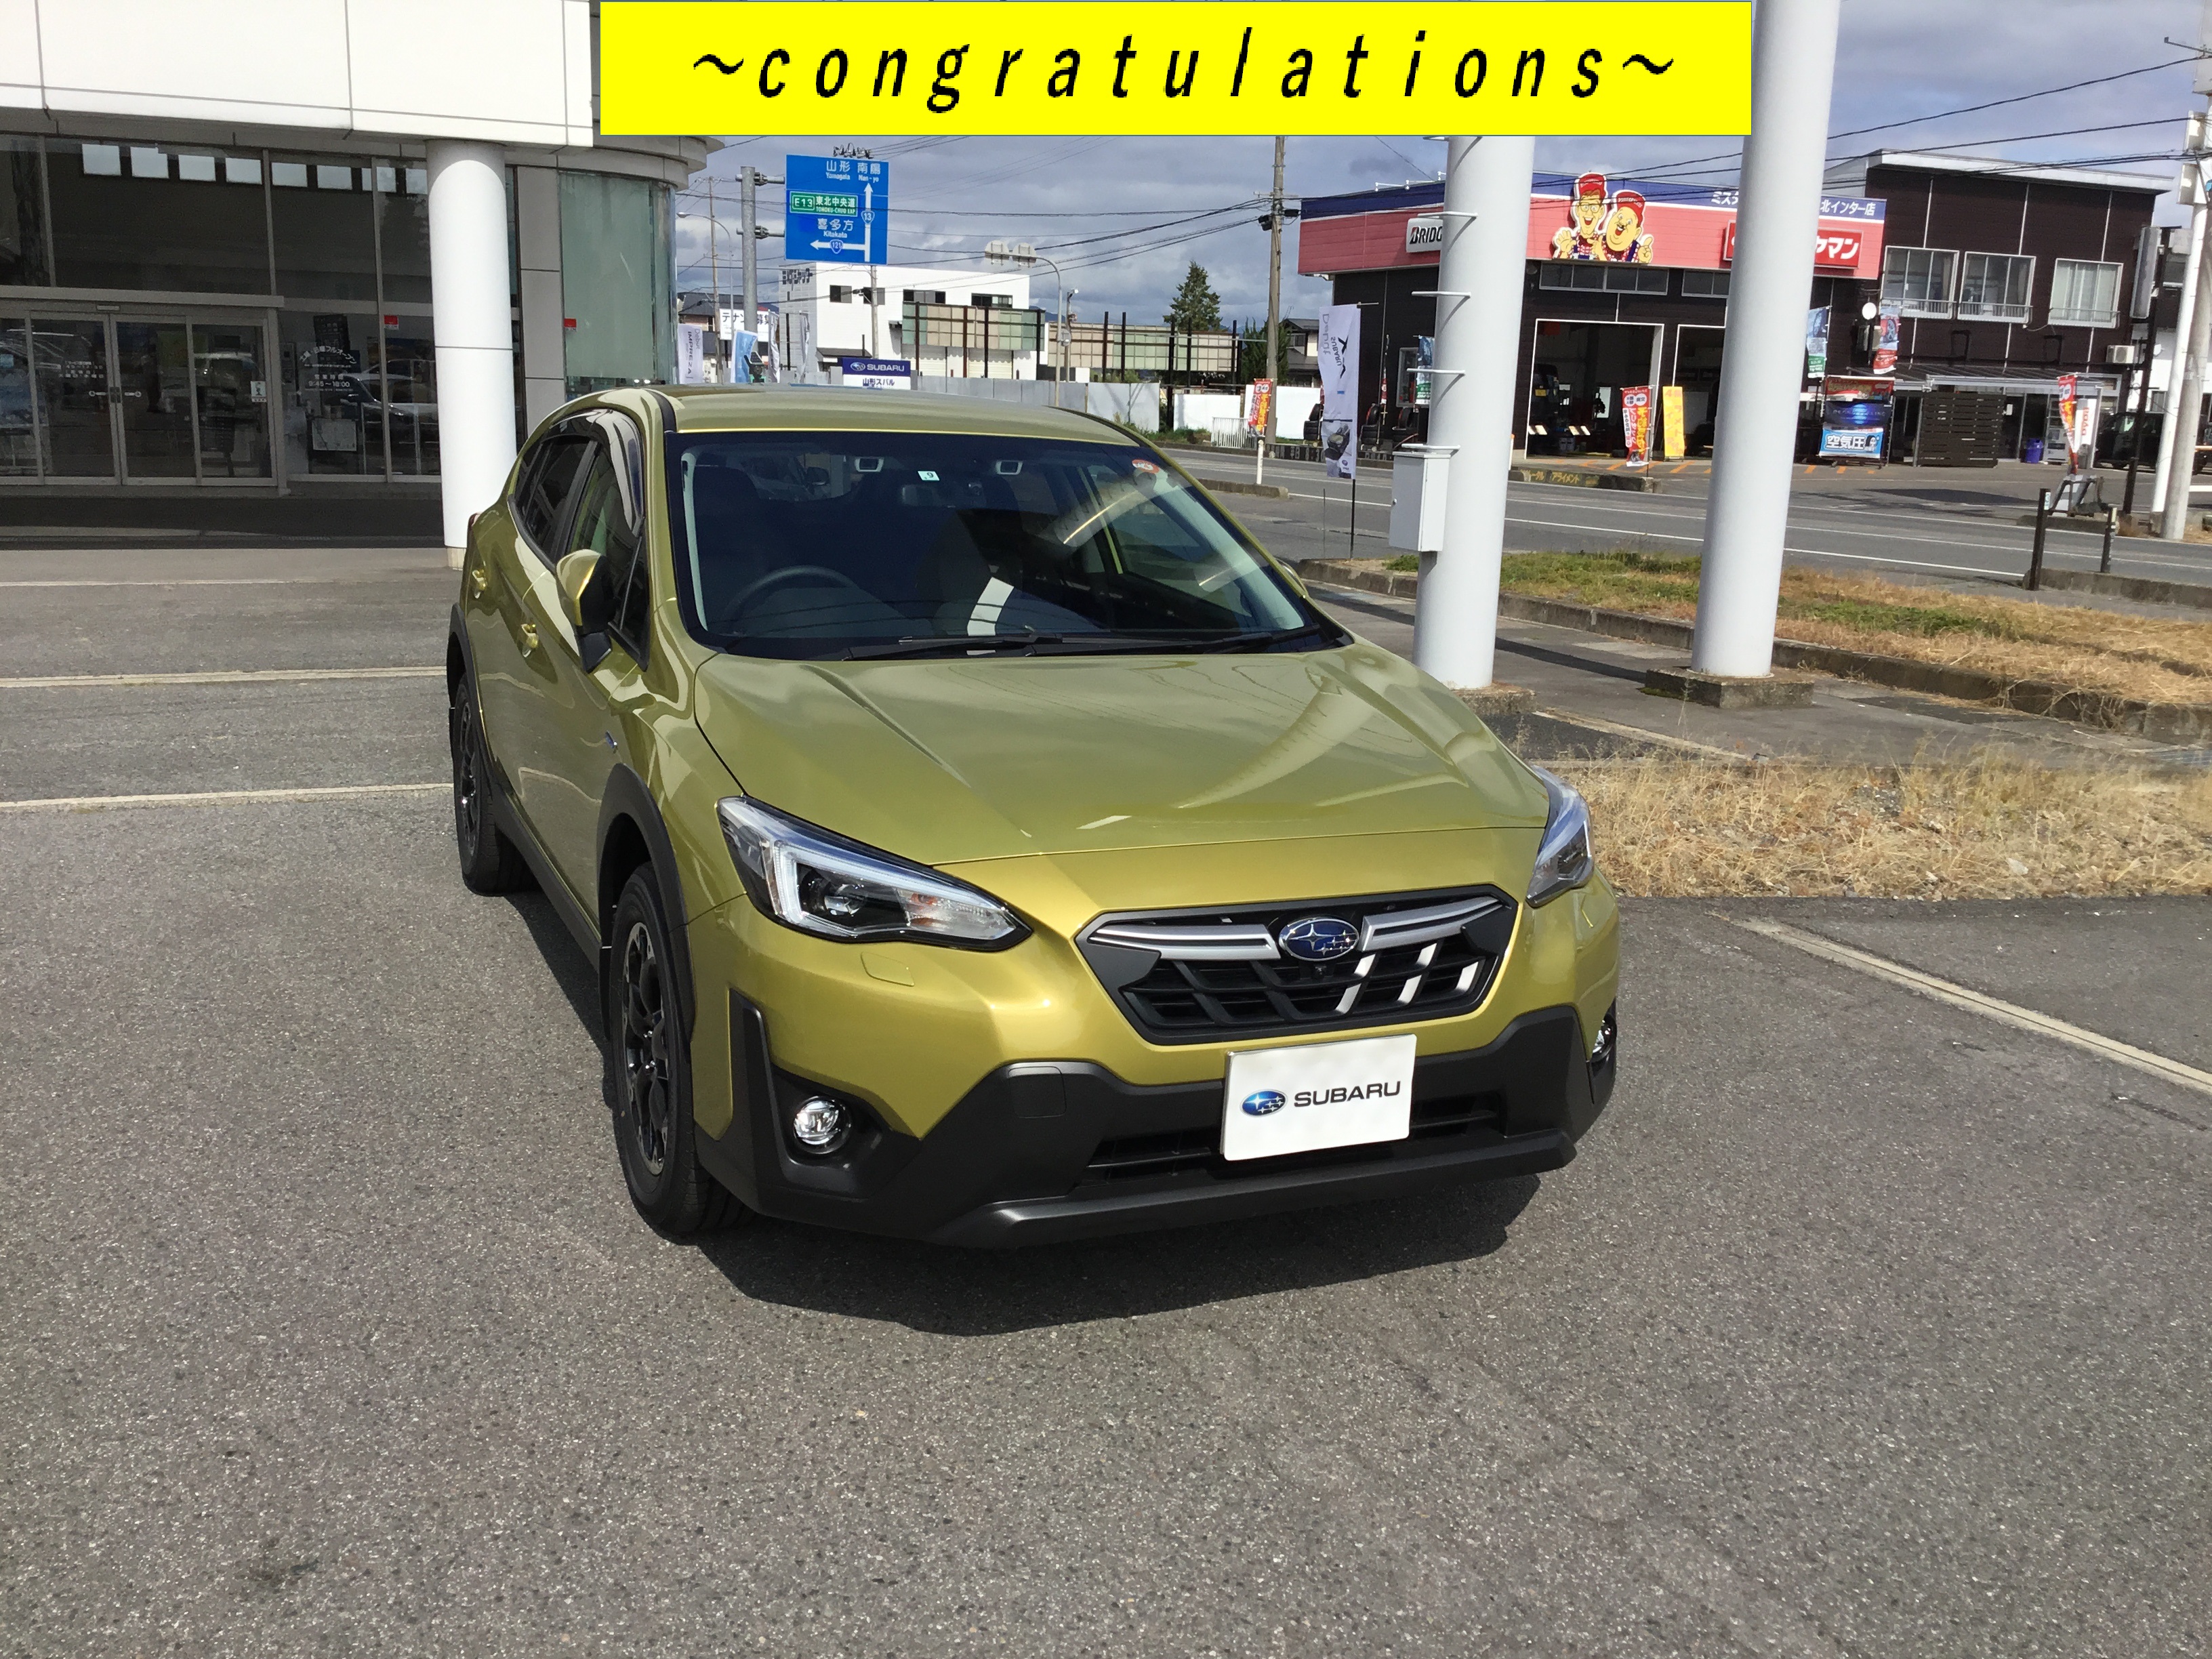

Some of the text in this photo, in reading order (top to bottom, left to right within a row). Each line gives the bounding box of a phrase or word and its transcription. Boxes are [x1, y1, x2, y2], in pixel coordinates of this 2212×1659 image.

[826, 160, 881, 175] 山形 南陽
[794, 197, 813, 207] E13
[815, 196, 856, 208] 東北中央道
[1820, 199, 1876, 216] 北インター店
[863, 211, 872, 220] 13
[817, 218, 854, 231] 喜多方
[832, 241, 842, 249] 121
[722, 312, 769, 325] テナン募
[866, 363, 905, 372] SUBARU
[862, 377, 895, 388] 山形スバル
[1826, 434, 1865, 450] 空気圧
[1293, 1080, 1401, 1107] SUBARU
